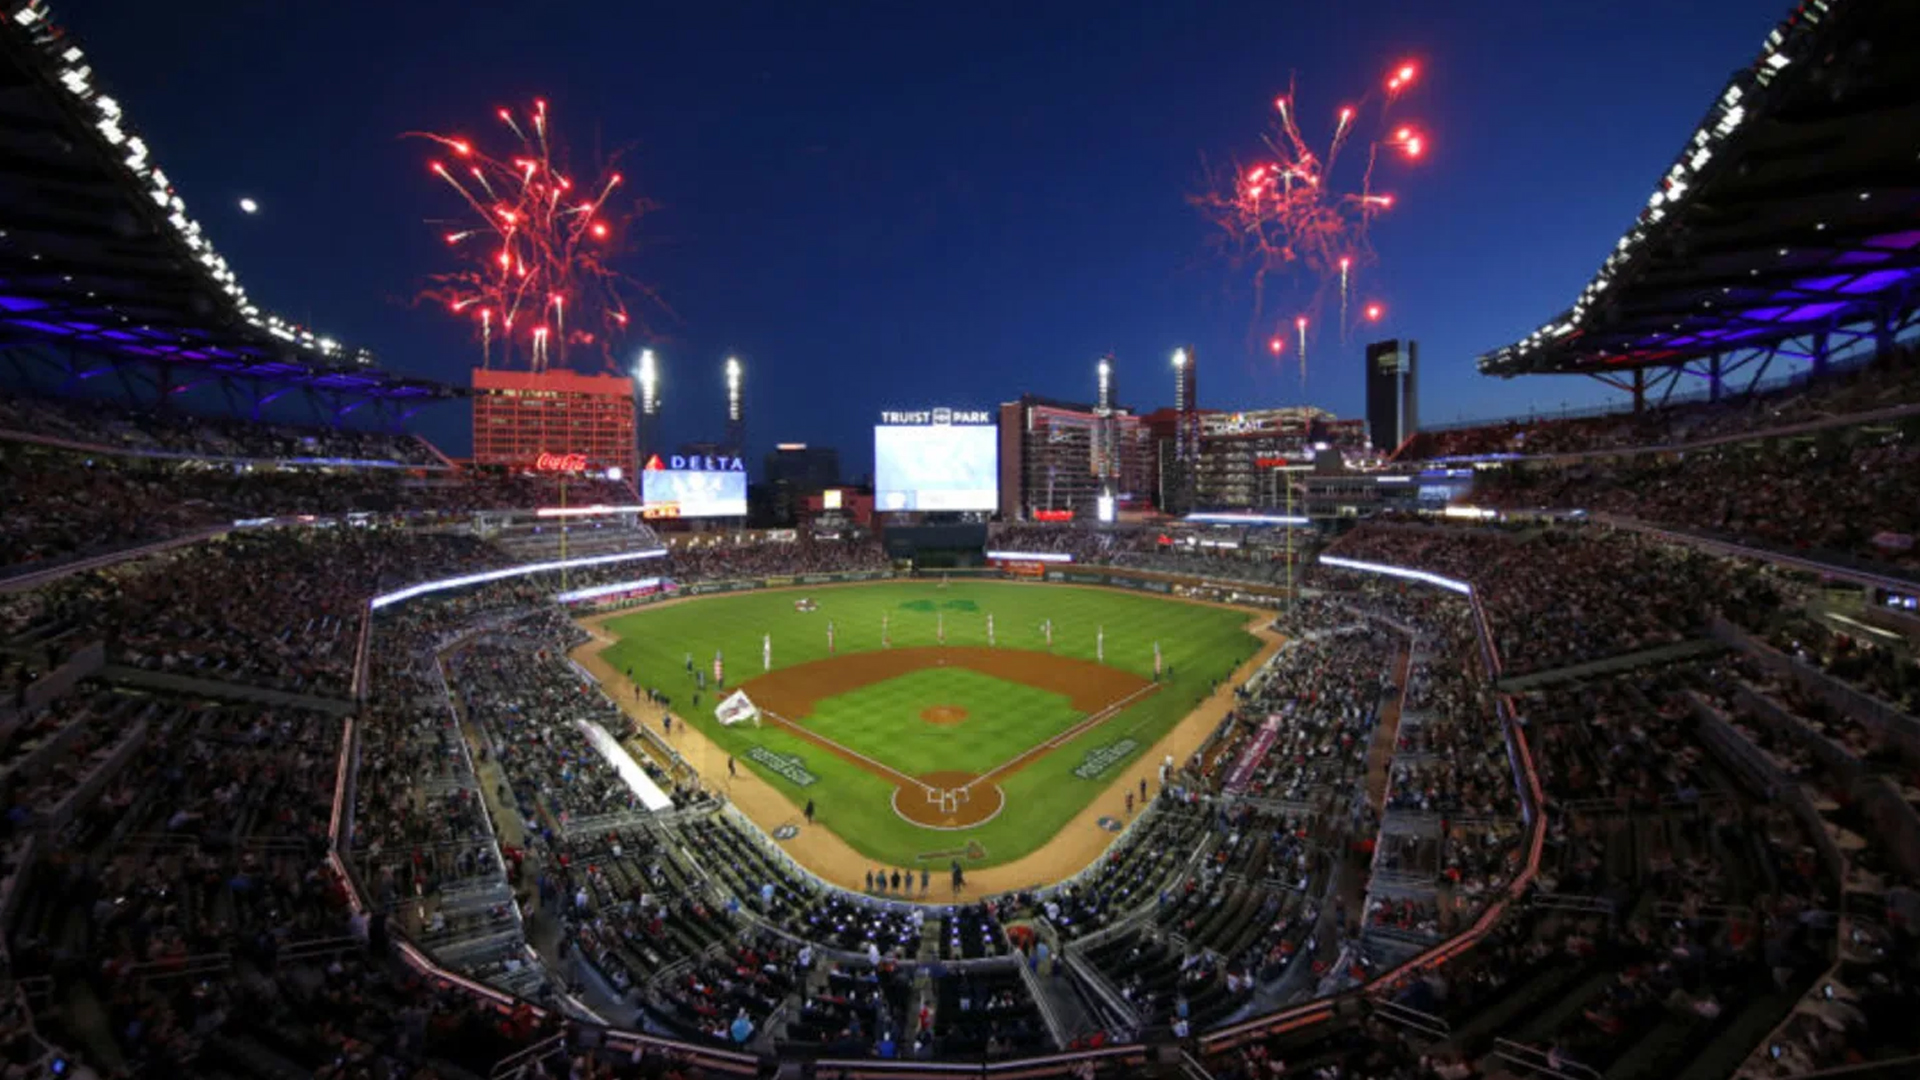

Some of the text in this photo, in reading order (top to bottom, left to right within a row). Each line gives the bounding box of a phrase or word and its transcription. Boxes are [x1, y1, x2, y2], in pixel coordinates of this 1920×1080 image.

[881, 411, 931, 423] TRUIST
[952, 411, 989, 423] PARK
[671, 455, 743, 470] DELTA
